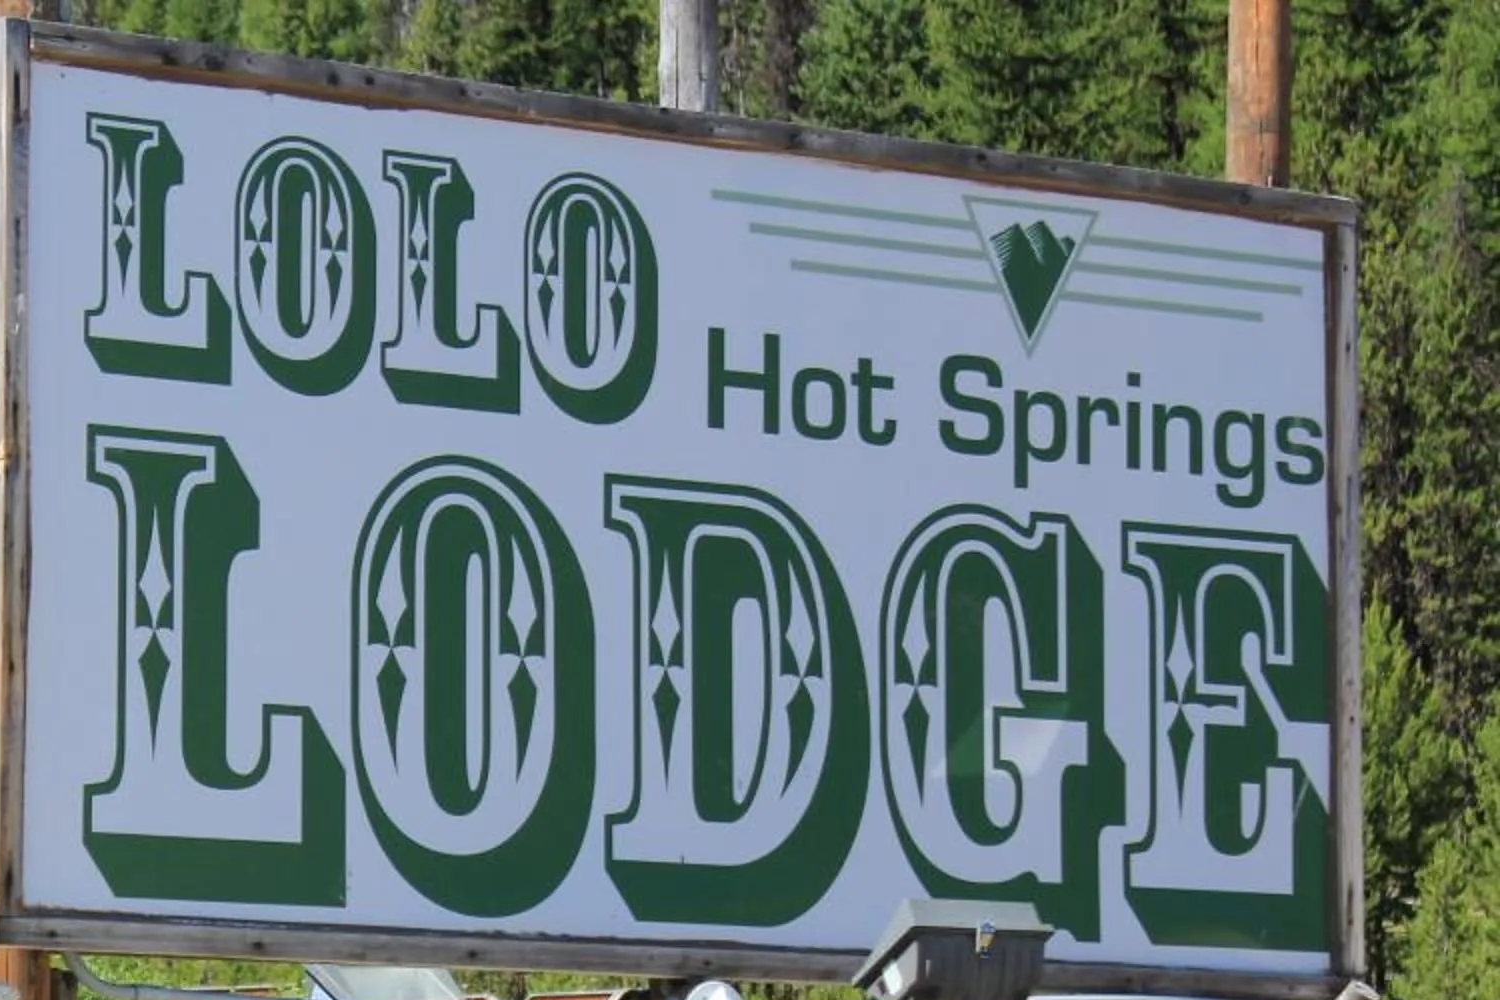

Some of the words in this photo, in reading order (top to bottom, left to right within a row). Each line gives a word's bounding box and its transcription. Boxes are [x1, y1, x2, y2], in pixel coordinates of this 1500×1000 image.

[84, 111, 659, 425] LOLO
[707, 327, 897, 446] Hot
[938, 354, 1326, 509] Springs
[83, 423, 1331, 952] LODGE
